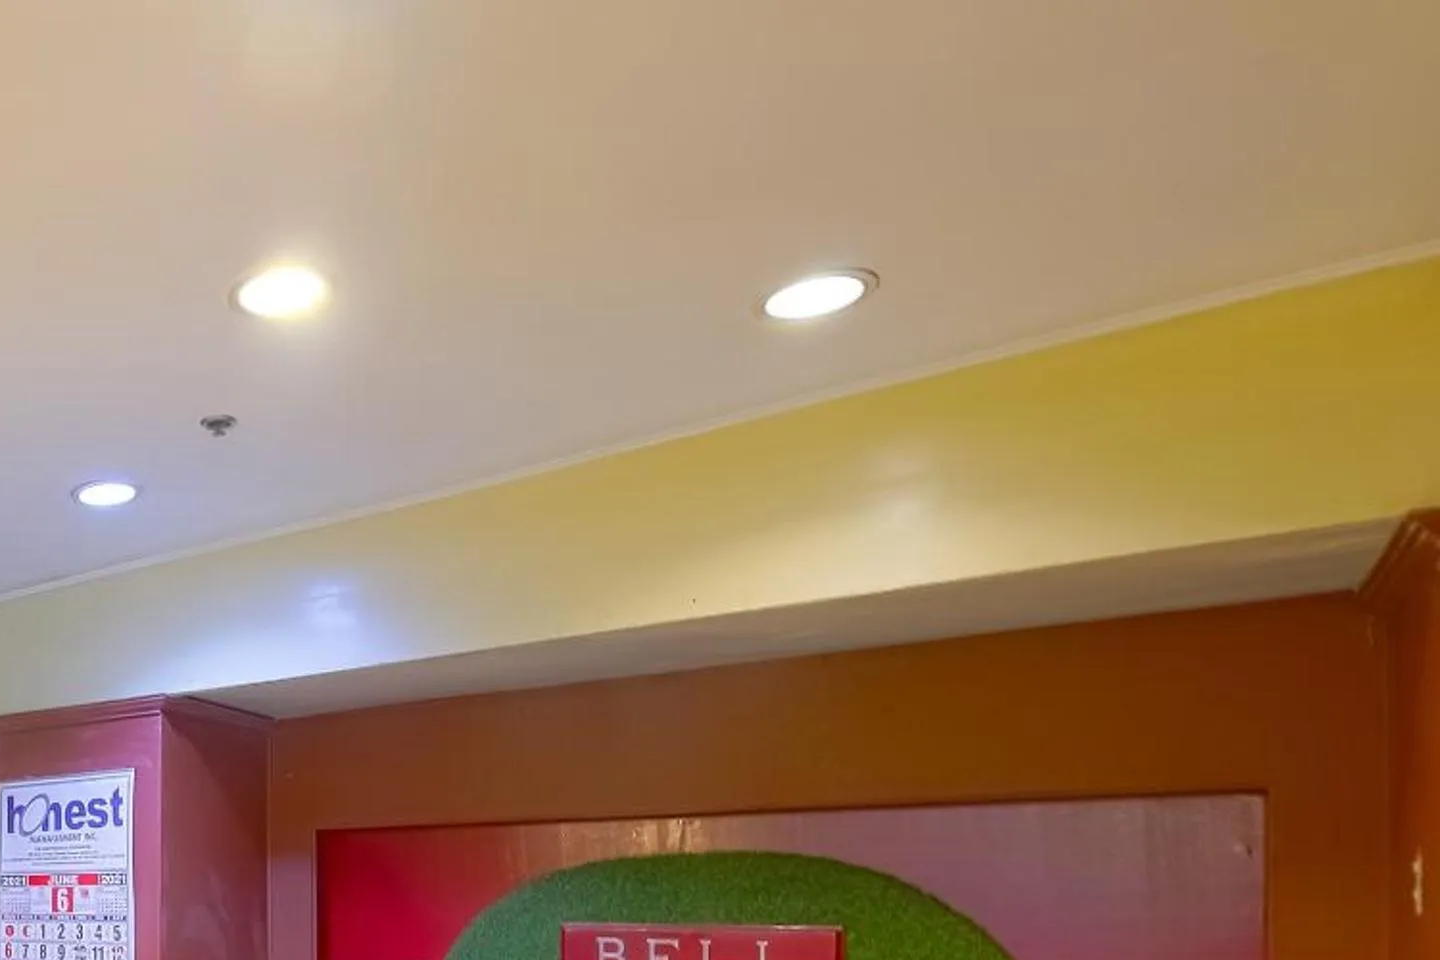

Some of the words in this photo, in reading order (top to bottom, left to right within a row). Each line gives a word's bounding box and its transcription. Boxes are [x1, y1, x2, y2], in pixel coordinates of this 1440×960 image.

[7, 786, 124, 837] honest
[2, 876, 27, 887] 2021
[57, 888, 69, 912] 6
[41, 924, 46, 939] 1
[57, 923, 66, 939] 2
[76, 924, 84, 940] 3
[94, 925, 103, 940] 4
[113, 925, 122, 941] 5
[5, 943, 13, 959] 6
[22, 944, 29, 958] 7
[40, 944, 47, 959] 8
[58, 945, 66, 960] 9
